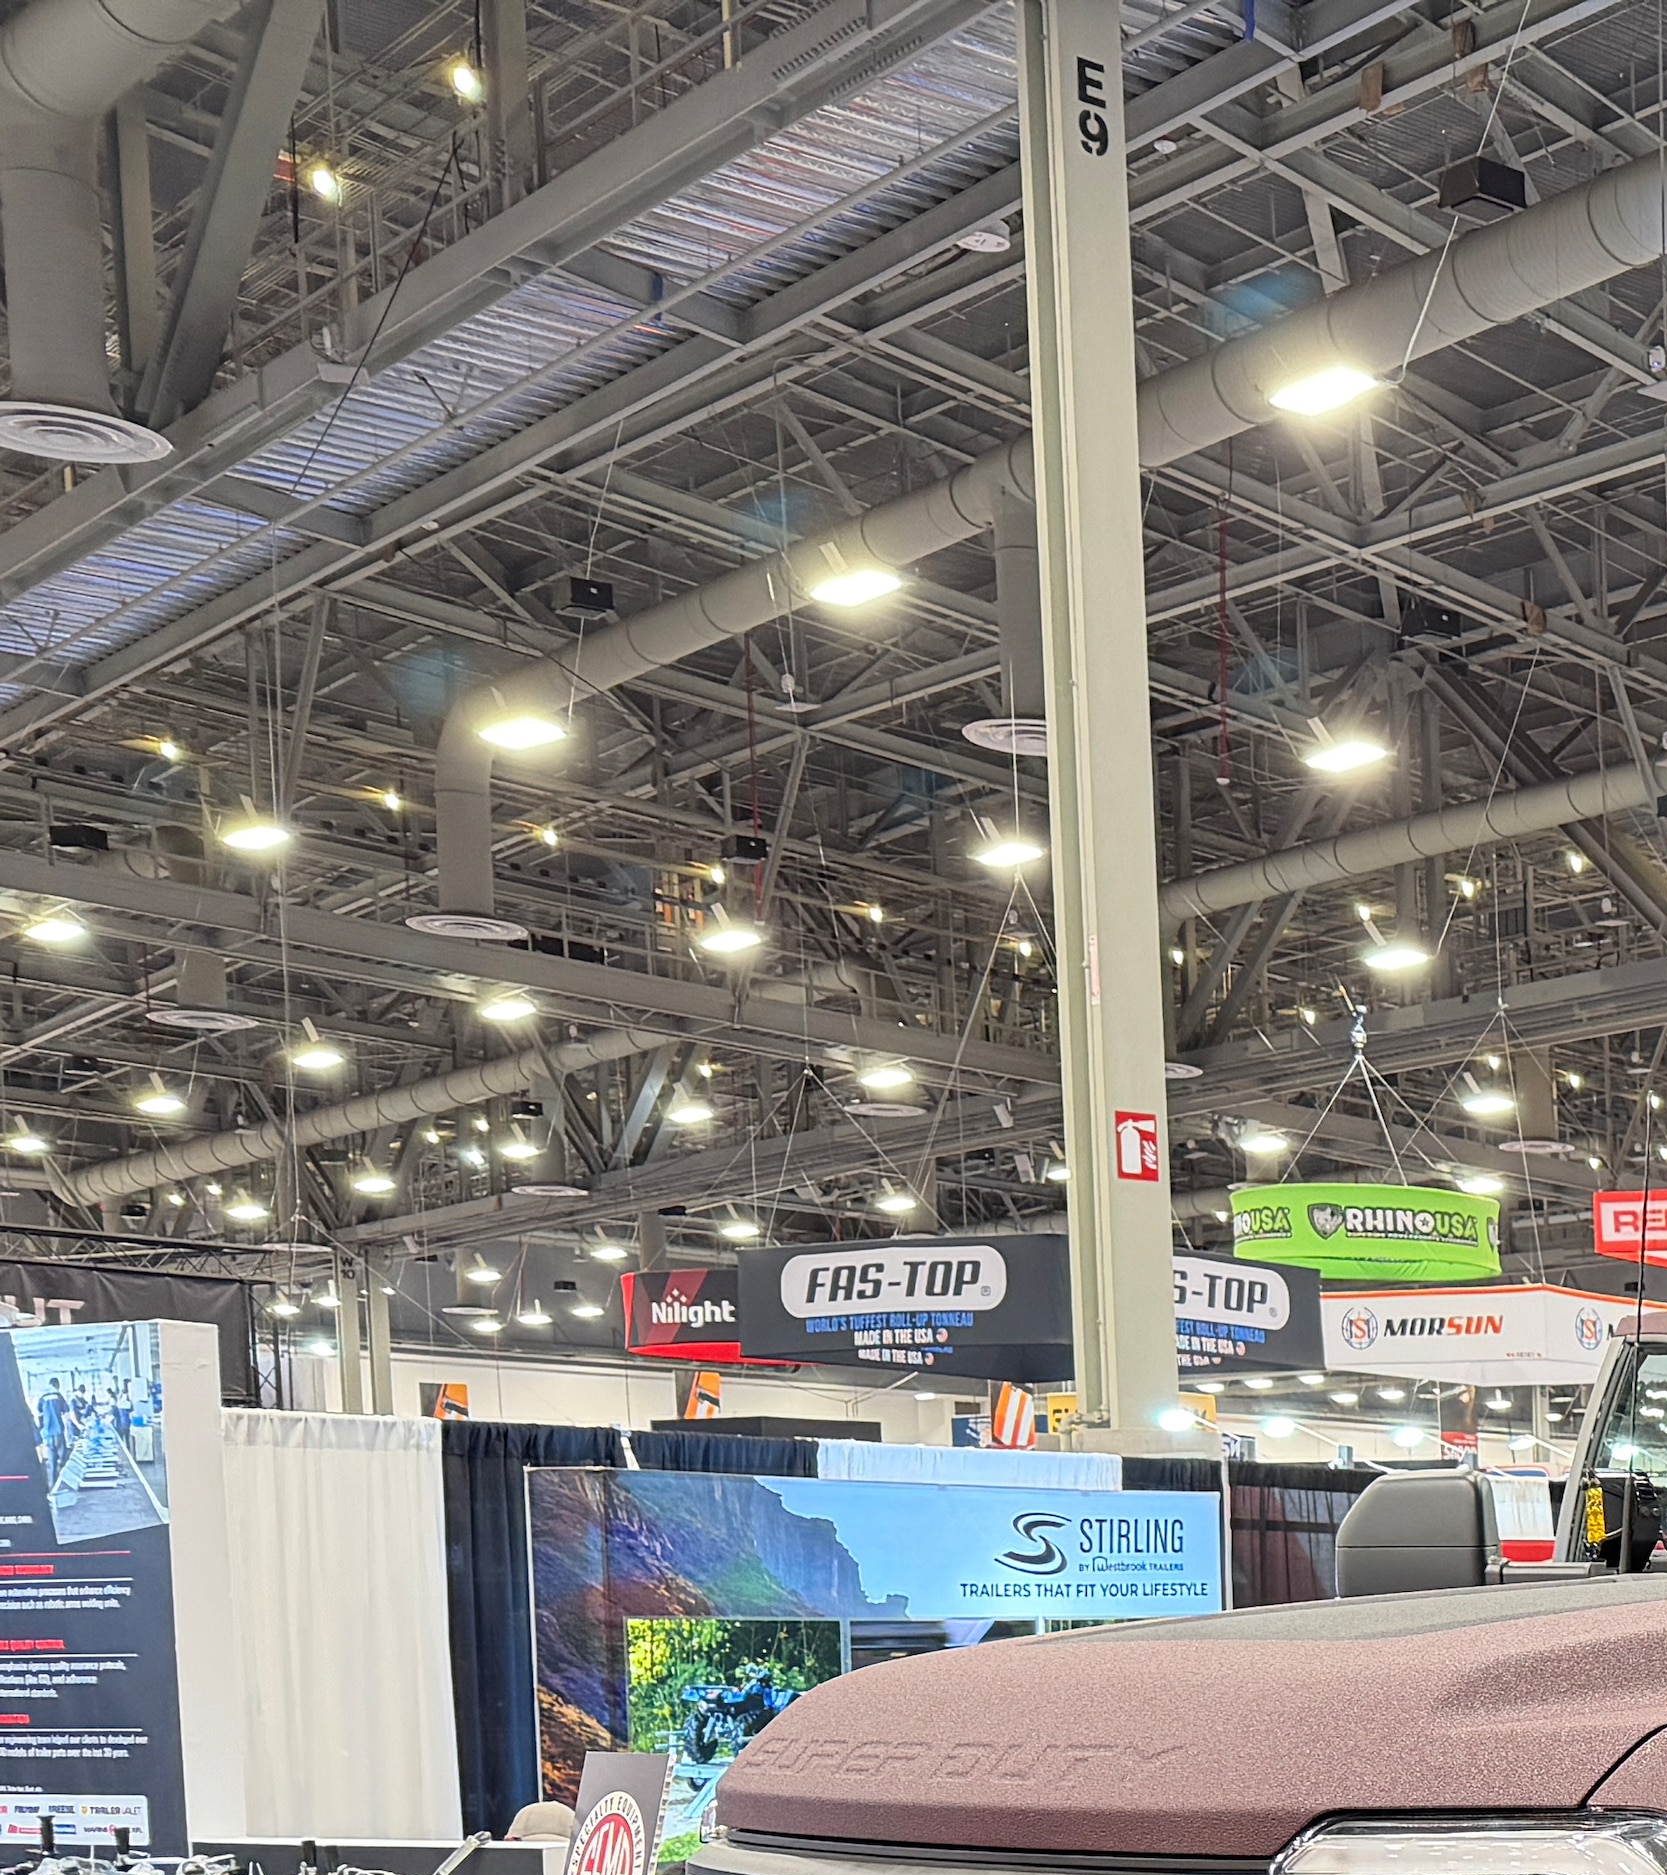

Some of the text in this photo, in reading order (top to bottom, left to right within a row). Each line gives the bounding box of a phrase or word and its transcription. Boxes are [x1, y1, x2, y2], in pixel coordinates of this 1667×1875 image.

[805, 1260, 982, 1304] FAS-TOP
[1174, 1269, 1268, 1313] S-TOP
[651, 1300, 736, 1327] Nilight
[1384, 1315, 1504, 1337] MORSUN
[854, 1328, 934, 1346] MADE IN THE USA
[1079, 1518, 1184, 1554] STIRLING
[1149, 1563, 1184, 1571] TRAILERS
[960, 1582, 1208, 1598] TRAILERS THAT FIT YOUR LIFESTYLE
[744, 1736, 1192, 1785] SUPER DUTY
[570, 1802, 616, 1866] SPECIALTY
[616, 1793, 643, 1869] EQUIPMENT
